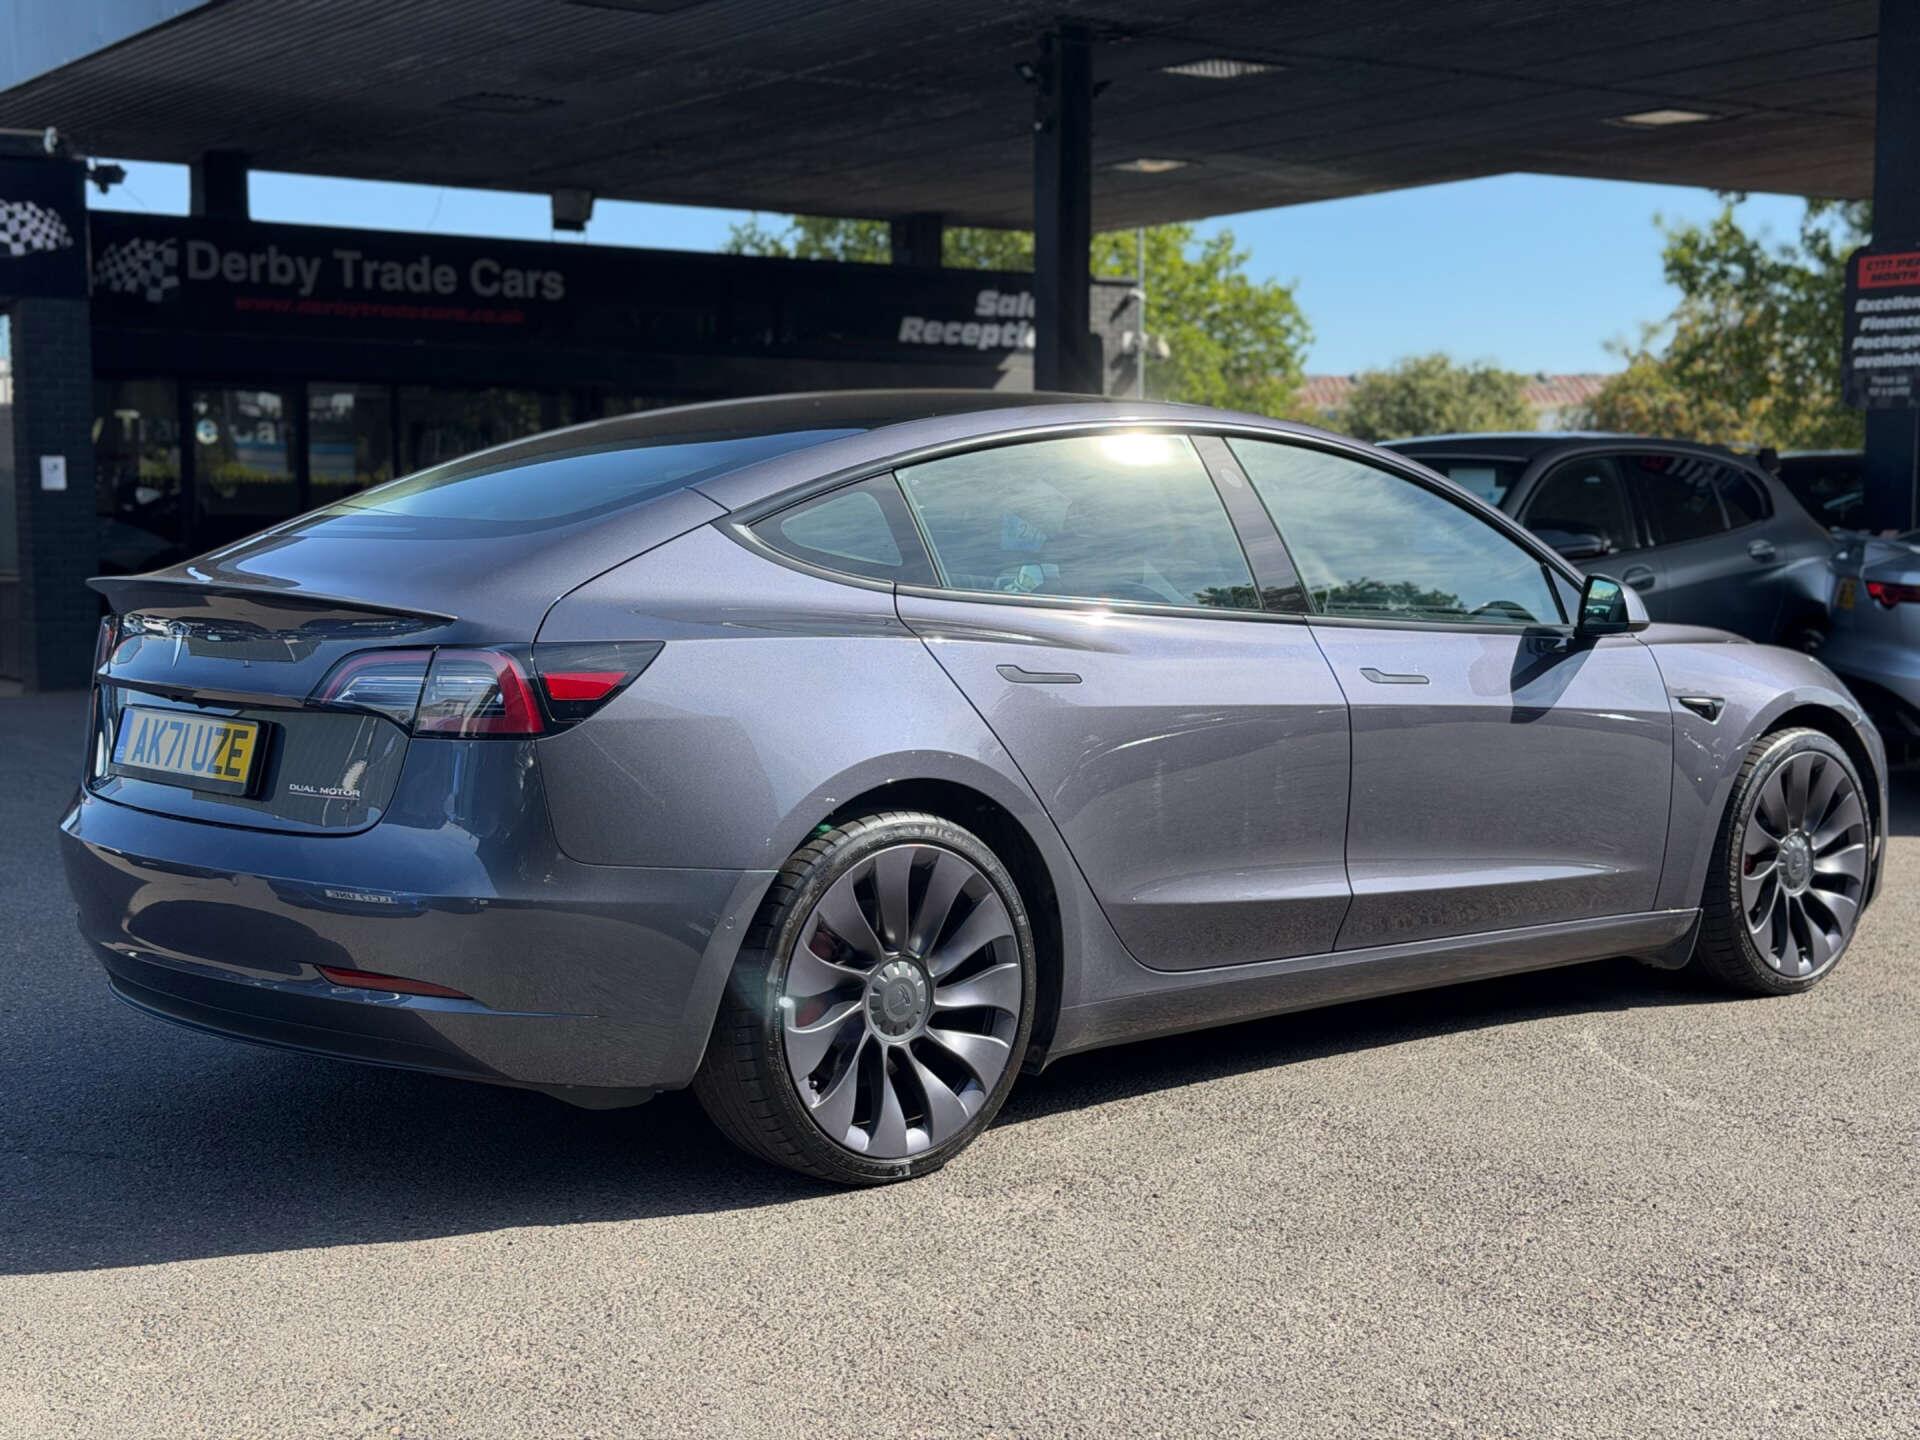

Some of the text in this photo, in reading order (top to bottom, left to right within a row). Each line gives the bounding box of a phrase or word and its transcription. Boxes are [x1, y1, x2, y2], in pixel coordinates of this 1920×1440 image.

[186, 240, 566, 301] Derby Trade Cars
[289, 783, 361, 797] DUAL MOTOR
